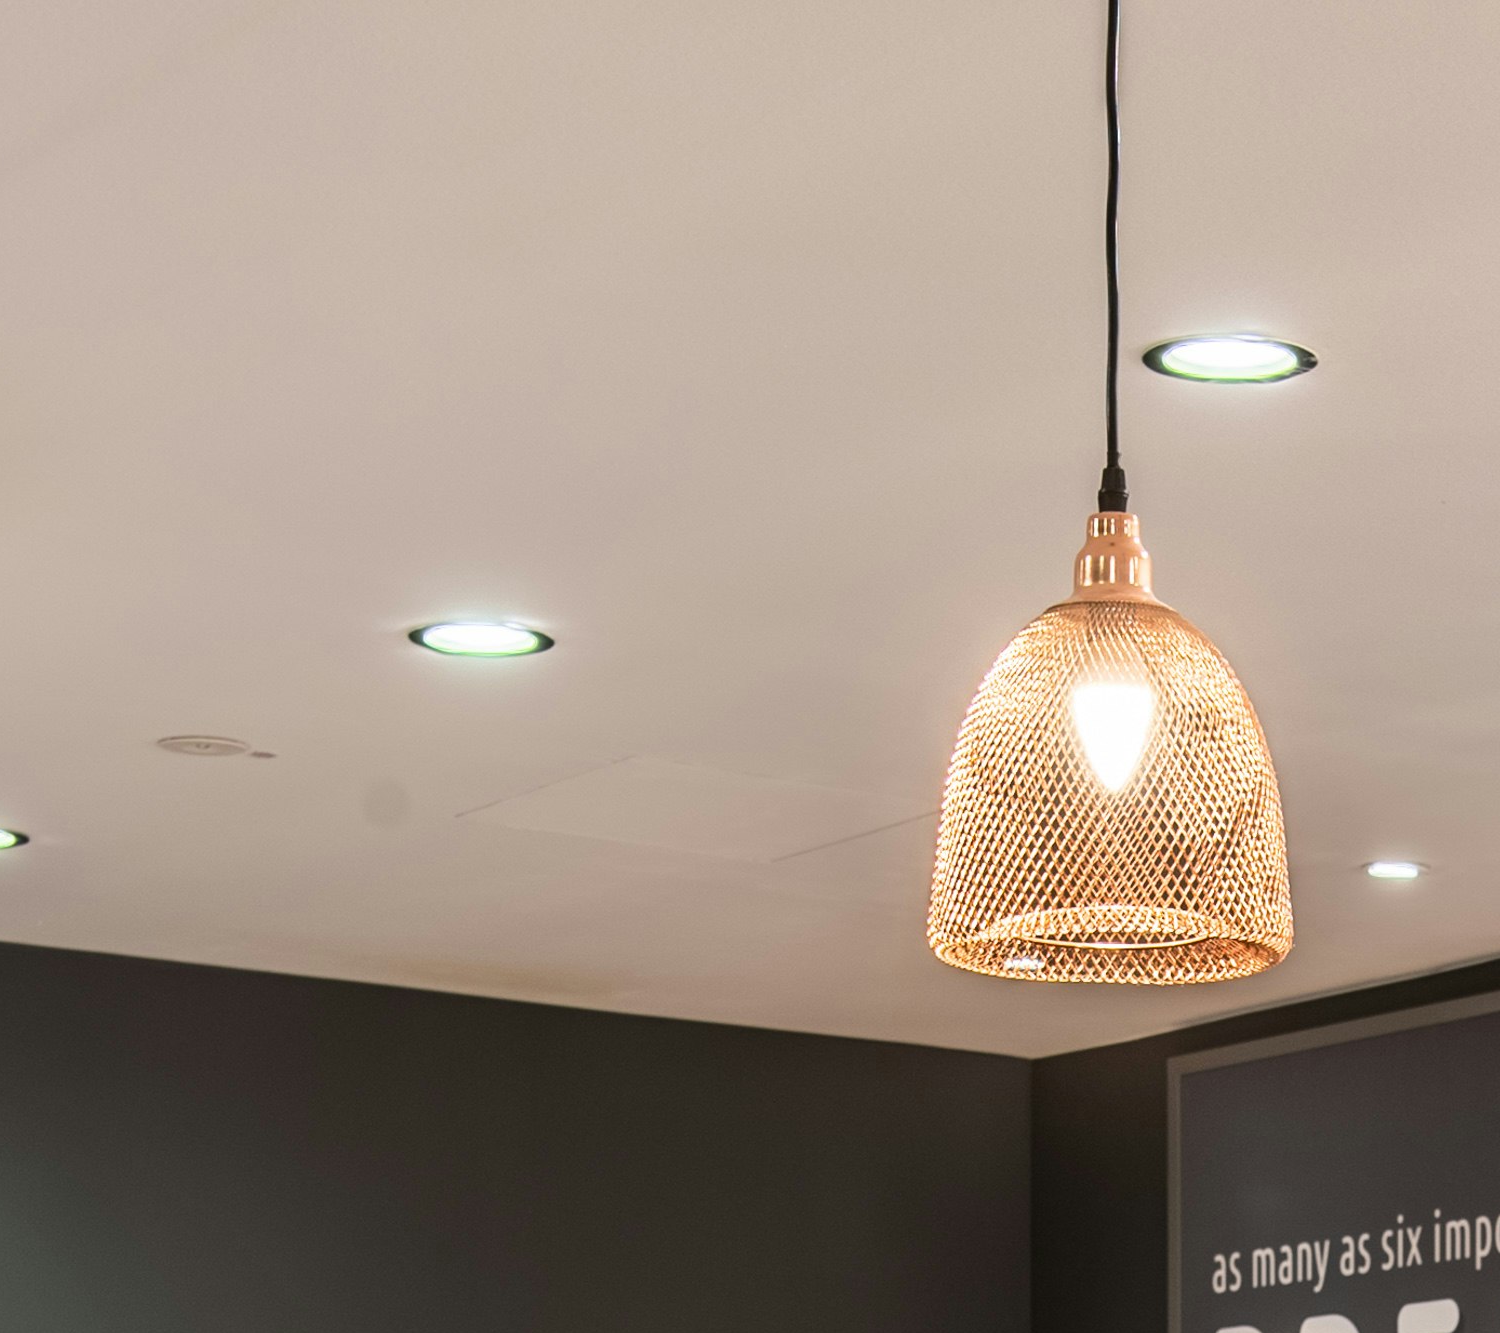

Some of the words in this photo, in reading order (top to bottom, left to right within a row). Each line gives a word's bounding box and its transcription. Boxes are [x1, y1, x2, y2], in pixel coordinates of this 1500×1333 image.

[1212, 1251, 1243, 1295] as
[1252, 1235, 1331, 1294] many
[1339, 1233, 1372, 1278] as
[1381, 1214, 1423, 1272] six
